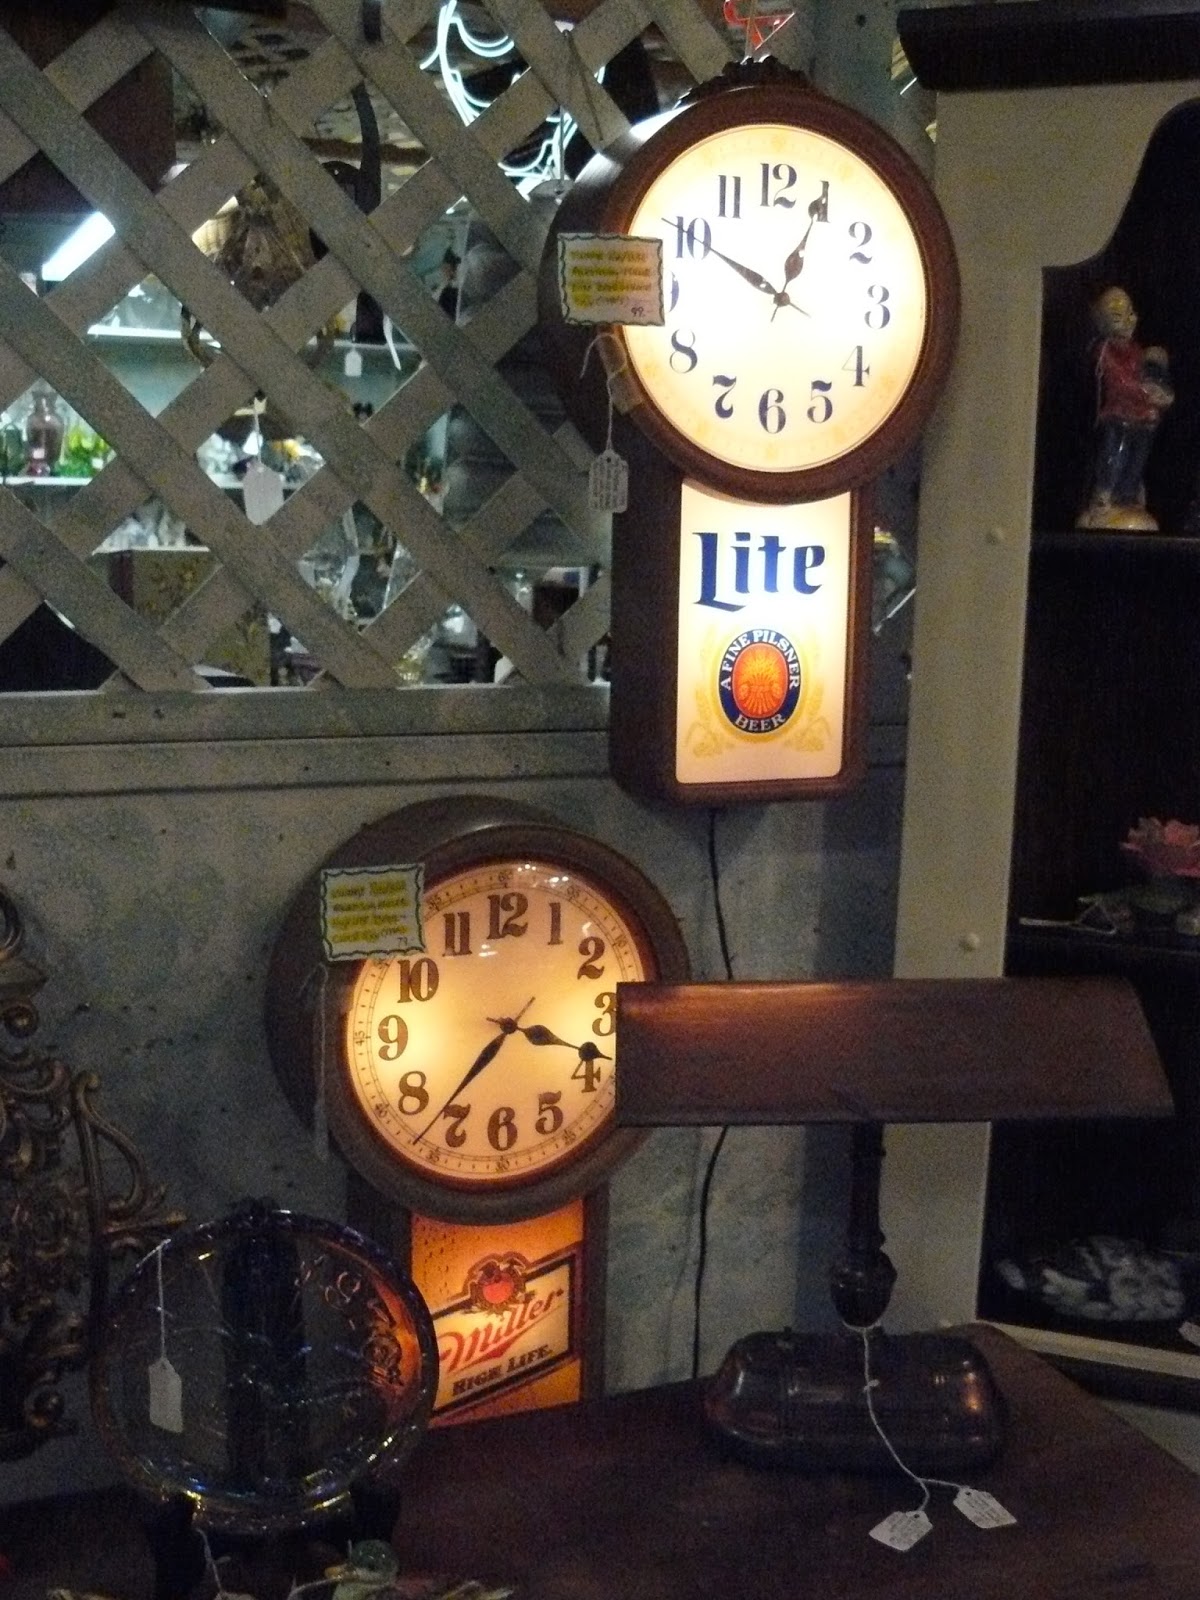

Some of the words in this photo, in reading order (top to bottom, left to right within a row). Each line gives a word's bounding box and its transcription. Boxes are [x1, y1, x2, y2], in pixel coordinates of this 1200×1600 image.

[718, 175, 742, 219] 11
[760, 162, 797, 209] 12
[814, 181, 831, 223] 1
[676, 216, 712, 260] 10
[848, 221, 873, 264] 2
[864, 284, 890, 329] 3
[669, 328, 698, 373] 8
[841, 345, 870, 387] 4
[712, 374, 737, 419] 7
[758, 388, 787, 434] 6
[807, 380, 833, 423] 5
[692, 532, 826, 613] Lite
[722, 633, 751, 673] FINE
[752, 629, 800, 691] PILSNER
[720, 676, 732, 691] A
[734, 713, 786, 732] BEER
[442, 911, 473, 957] 11
[487, 892, 529, 940] 12
[547, 902, 563, 945] 1
[397, 957, 440, 1003] 10
[577, 936, 605, 980] 2
[592, 992, 616, 1037] 3
[378, 1014, 409, 1061] 9
[398, 1070, 430, 1116] 8
[571, 1054, 601, 1093] 4
[443, 1103, 471, 1148] 7
[487, 1106, 518, 1151] 6
[535, 1090, 564, 1136] 5
[438, 1291, 557, 1374] Miller
[453, 1365, 502, 1396] HIGH
